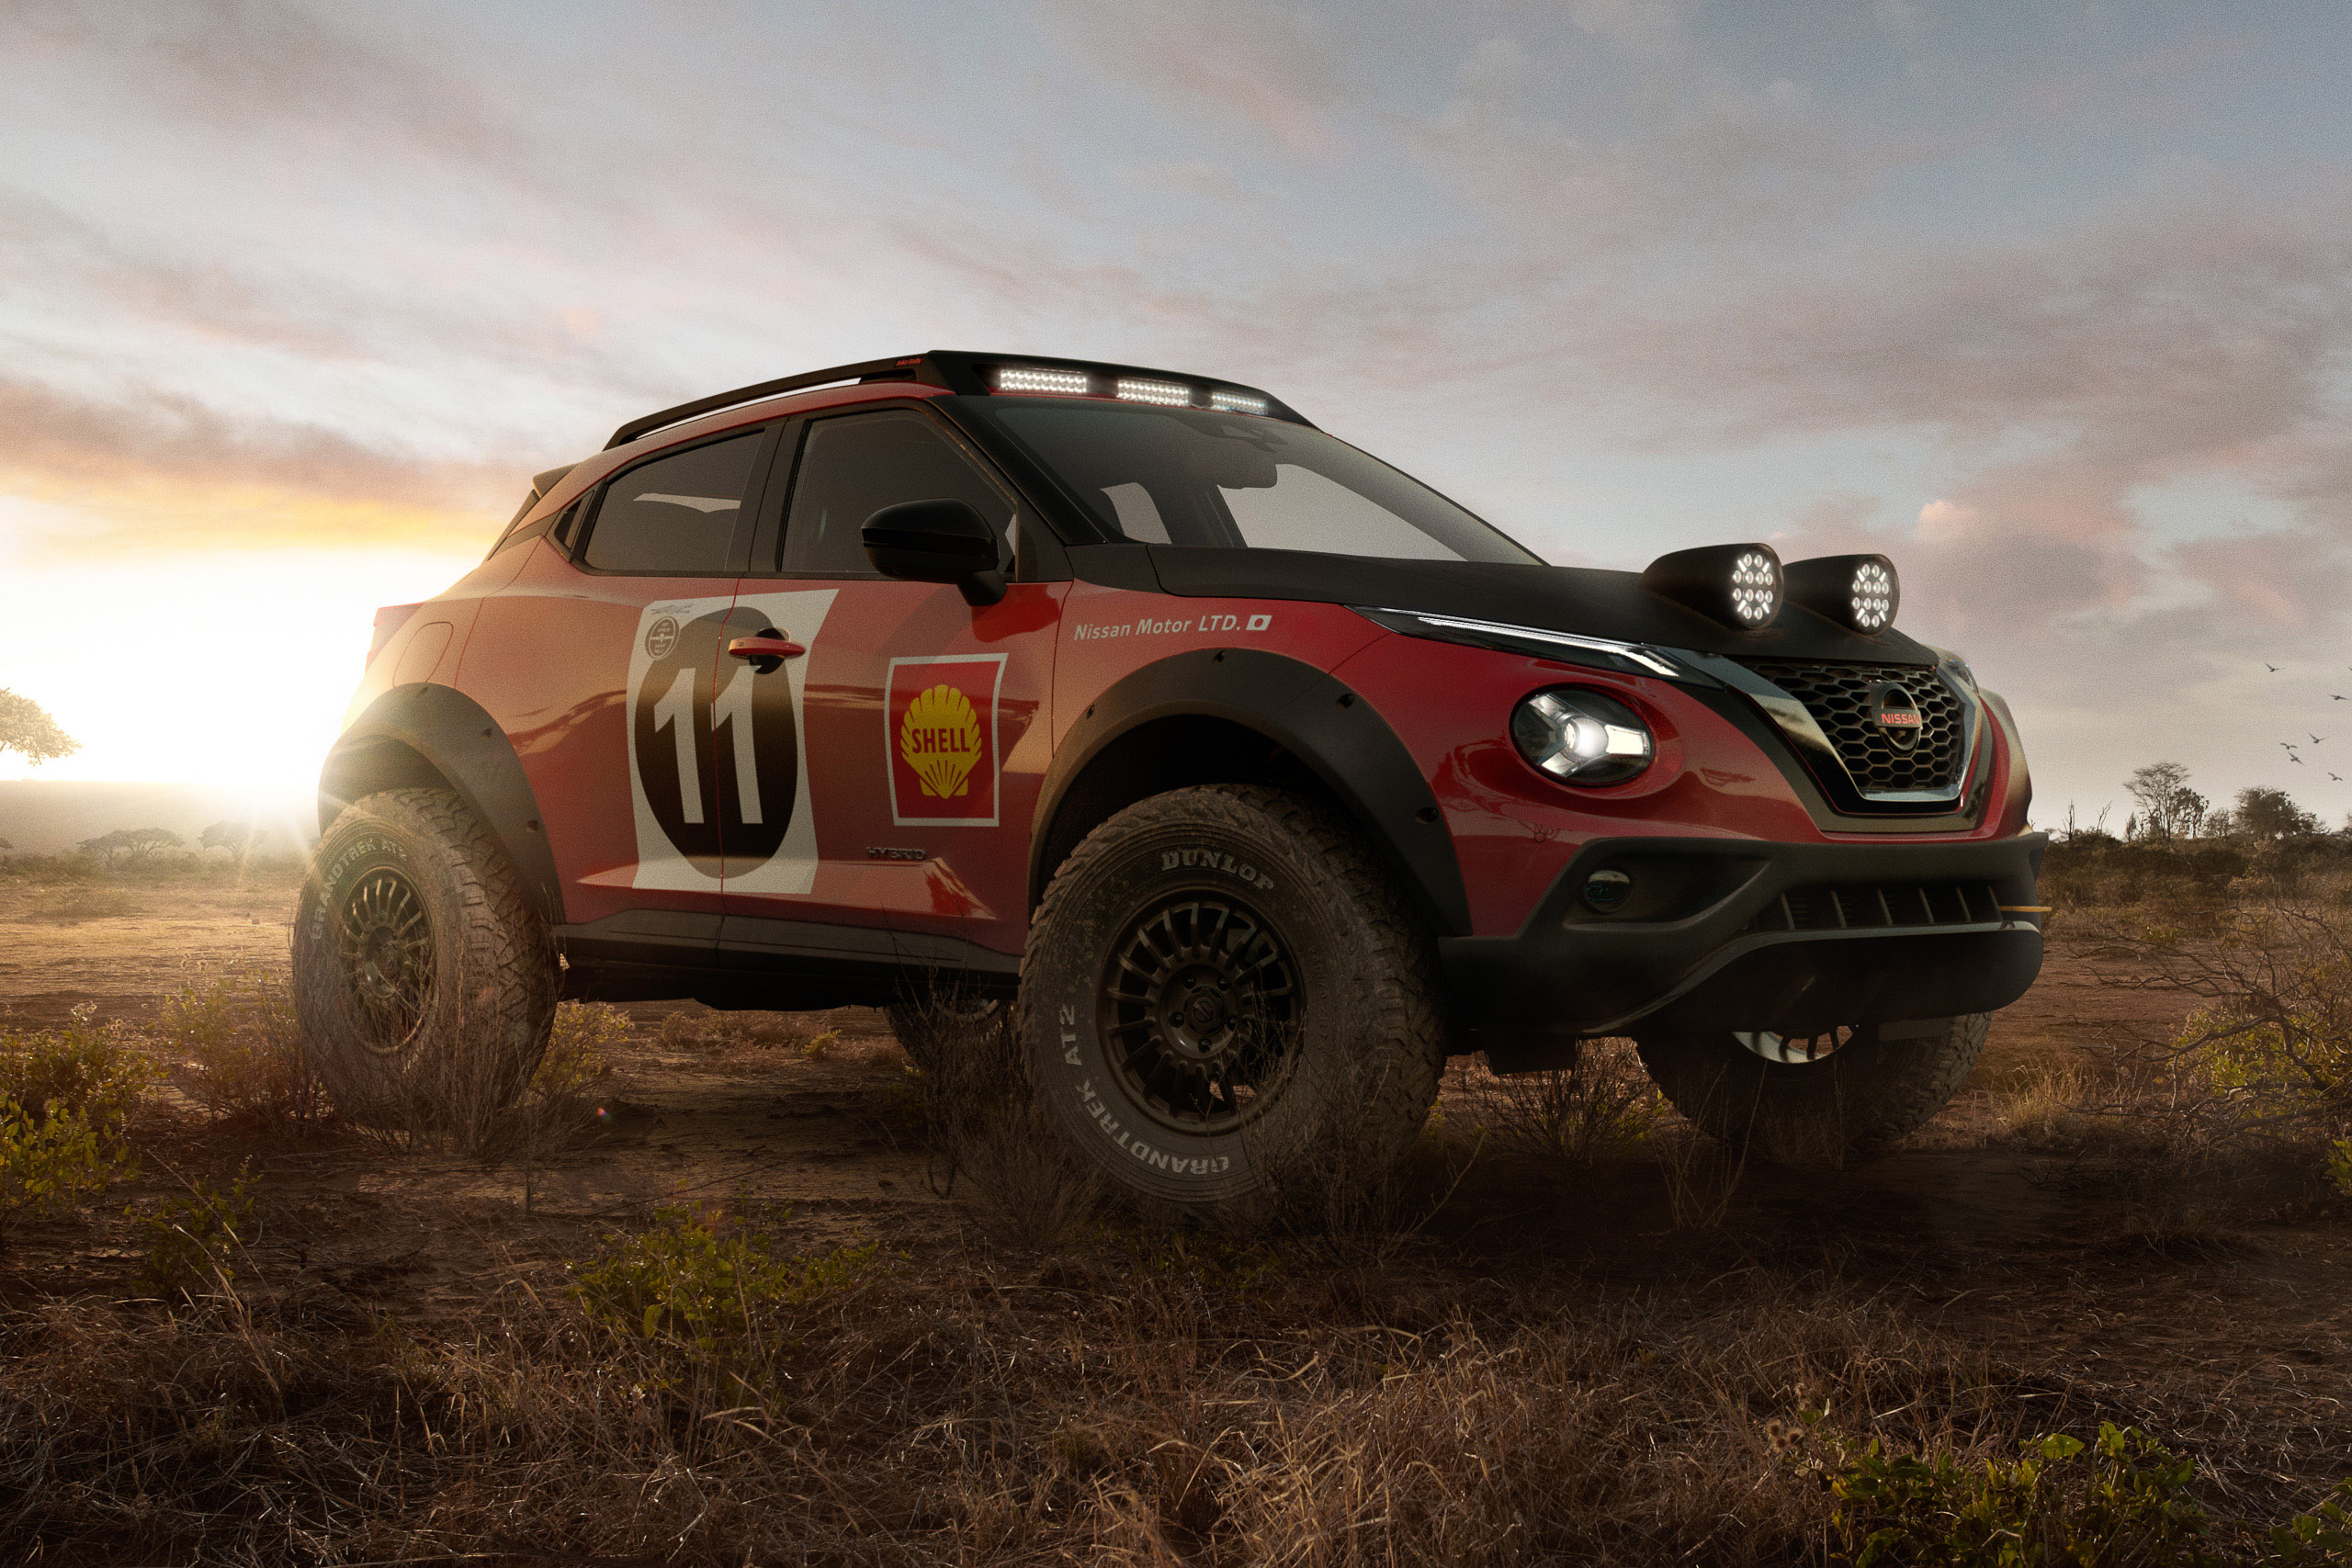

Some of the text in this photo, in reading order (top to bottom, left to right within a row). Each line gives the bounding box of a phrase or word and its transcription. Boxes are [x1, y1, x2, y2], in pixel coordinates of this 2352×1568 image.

[1074, 615, 1241, 640] Nissan Motor LTD.
[1882, 713, 1920, 725] NISSAN
[654, 667, 763, 824] 11
[912, 728, 970, 753] SHELL
[866, 847, 925, 860] HYBRID
[1161, 849, 1274, 889] DUNLOP
[313, 838, 377, 940] GRANDTREK
[1076, 1078, 1229, 1175] GRANDTREK
